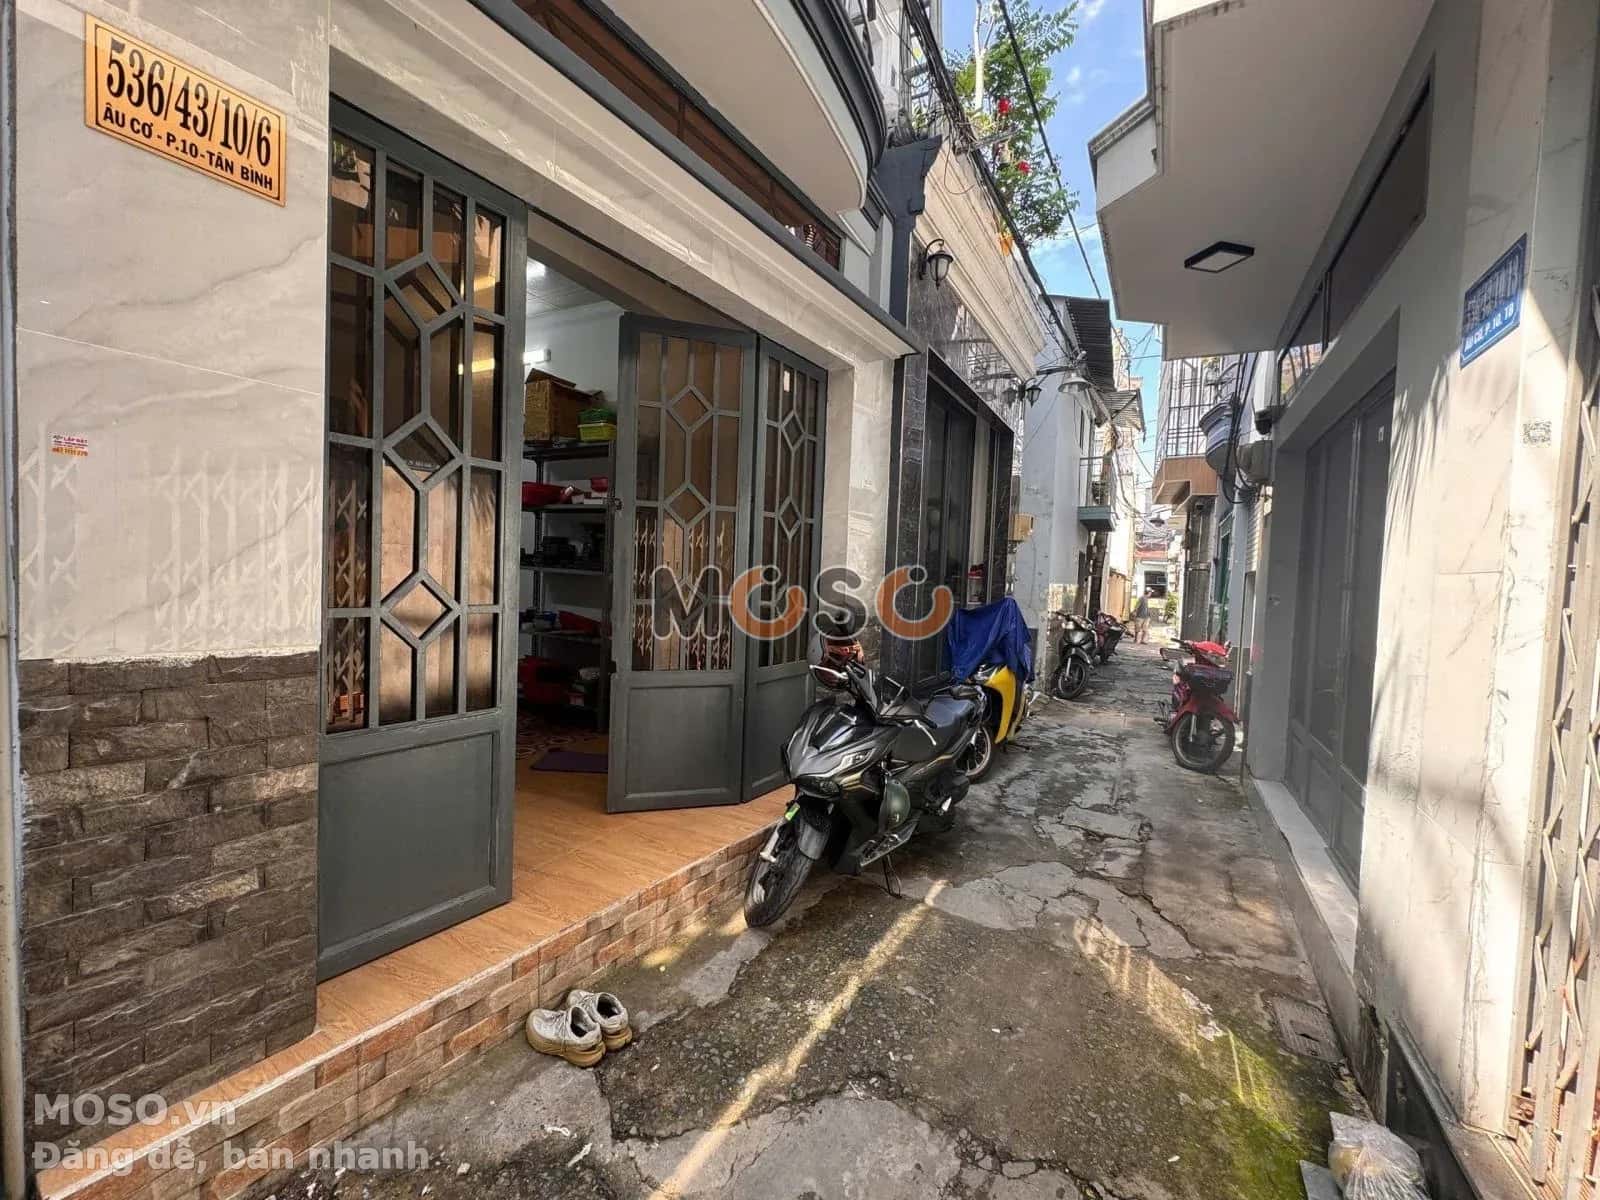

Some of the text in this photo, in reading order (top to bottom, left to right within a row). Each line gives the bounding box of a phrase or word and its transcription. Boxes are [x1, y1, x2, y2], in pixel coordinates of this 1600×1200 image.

[103, 102, 125, 128] ÂU
[130, 118, 153, 140] CƠ
[240, 164, 273, 192] BÌNH
[107, 37, 271, 167] 536/43/10/6
